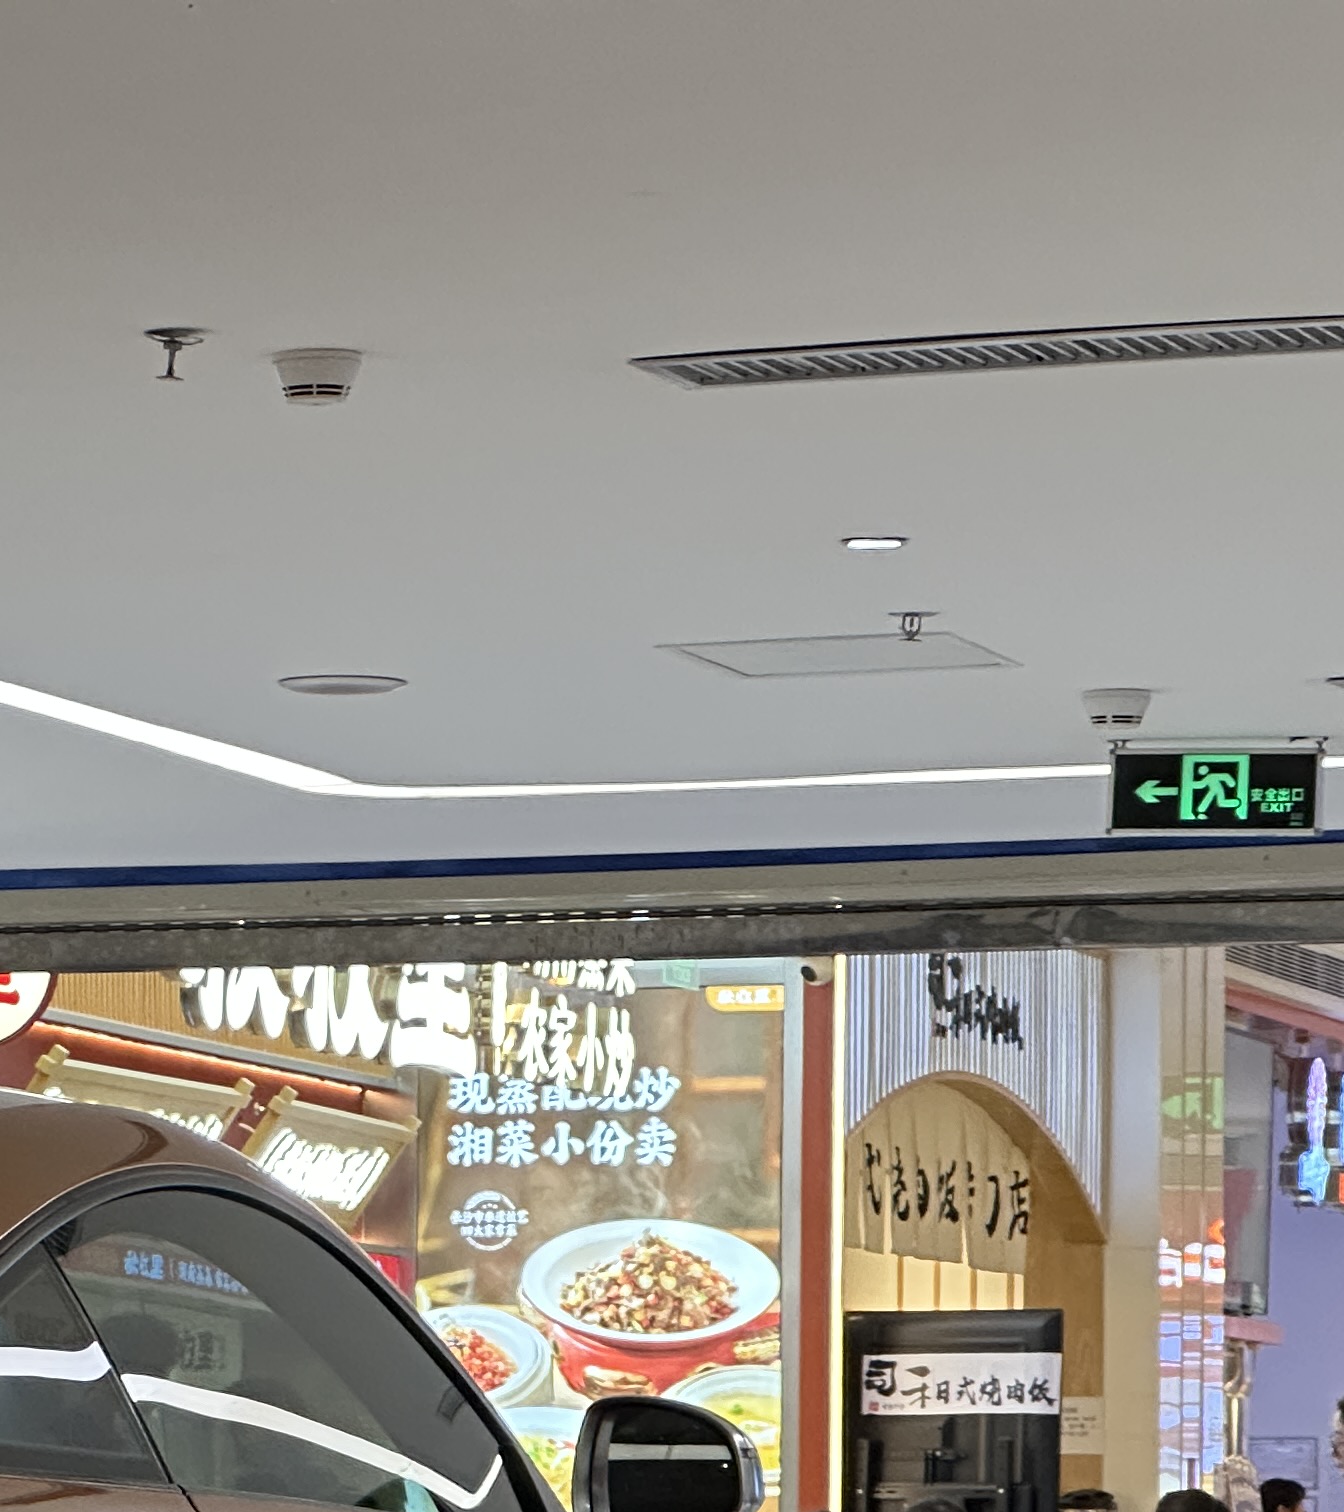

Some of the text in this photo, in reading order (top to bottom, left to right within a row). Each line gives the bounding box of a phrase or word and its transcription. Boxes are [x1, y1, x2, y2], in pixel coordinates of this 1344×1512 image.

[1250, 788, 1305, 802] 安全出口
[1260, 803, 1295, 813] EXIT
[446, 1117, 679, 1168] 湘菜小份卖
